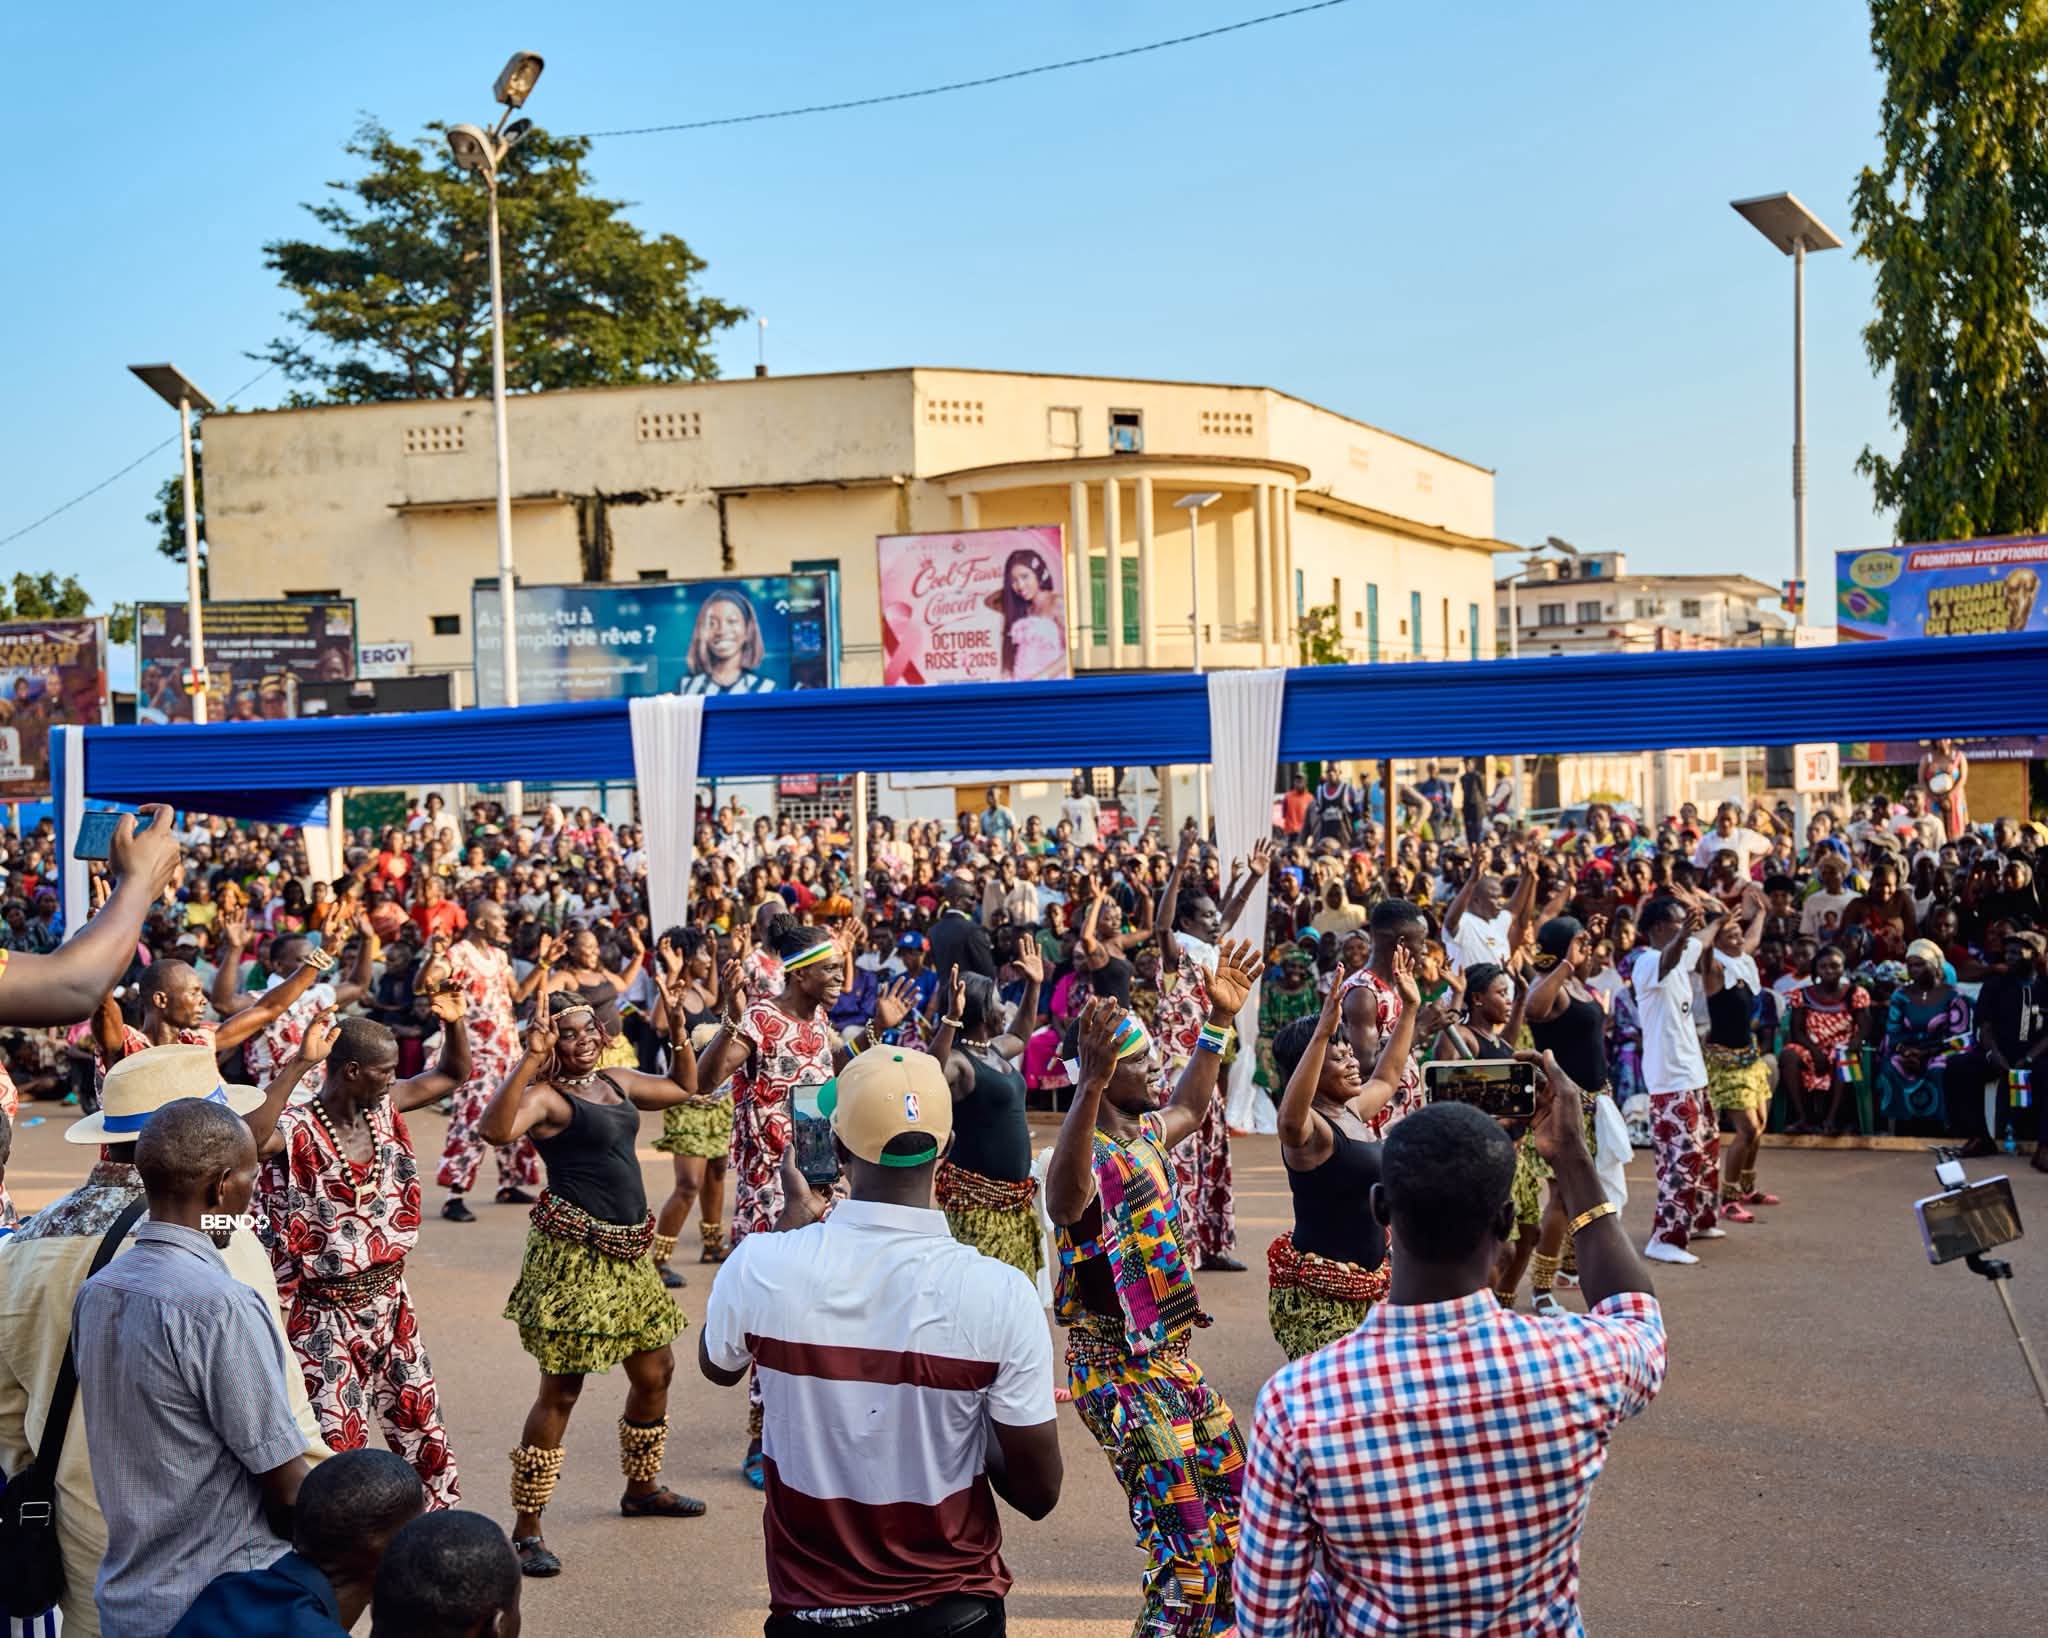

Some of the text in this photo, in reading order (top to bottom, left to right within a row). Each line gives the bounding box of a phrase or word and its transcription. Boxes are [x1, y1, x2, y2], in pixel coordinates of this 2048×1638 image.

[1913, 552, 1973, 568] PROMOTION
[1929, 581, 2005, 606] PENDANT
[580, 605, 594, 625] à
[1931, 606, 1950, 619] LA
[601, 627, 643, 645] rêve
[645, 625, 657, 644] ?
[1924, 614, 2010, 636] DU MONDE
[931, 630, 992, 650] OCTOBRE
[924, 651, 958, 670] ROSE
